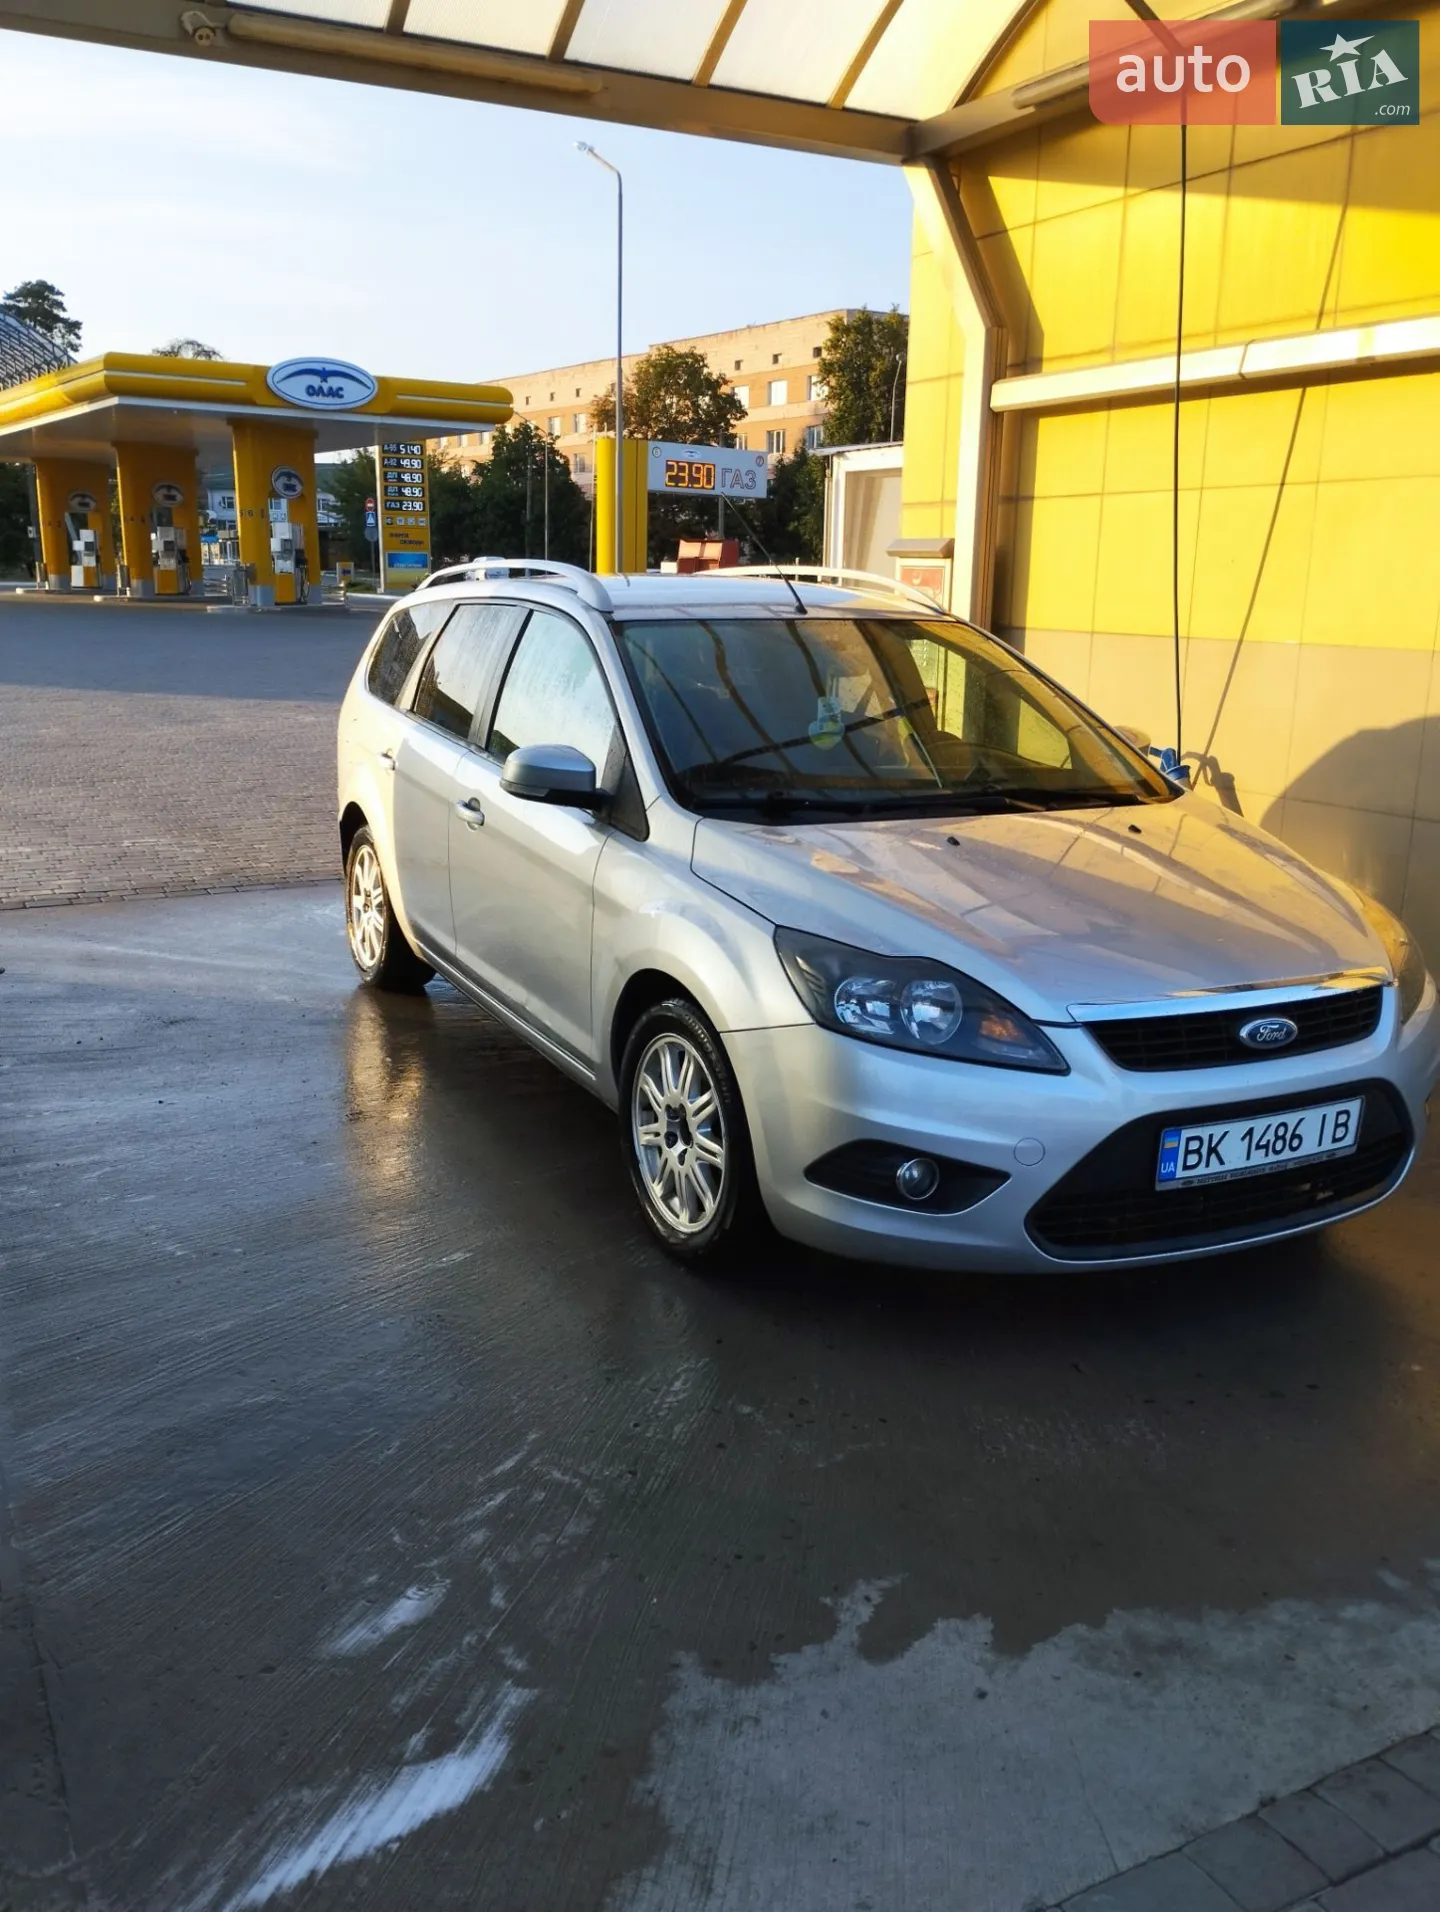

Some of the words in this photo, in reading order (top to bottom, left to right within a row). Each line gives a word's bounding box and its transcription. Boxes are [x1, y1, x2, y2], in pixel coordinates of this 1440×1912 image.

[304, 384, 345, 399] ОЛАС
[665, 461, 715, 489] 23.90
[720, 467, 757, 490] ГАЗ
[401, 487, 423, 497] 48.90
[402, 501, 423, 511] 23.90
[1256, 1024, 1287, 1041] Ford
[1181, 1130, 1230, 1171] BK
[1240, 1116, 1307, 1161] 1486
[1317, 1109, 1350, 1148] IB
[1160, 1162, 1175, 1174] UA
